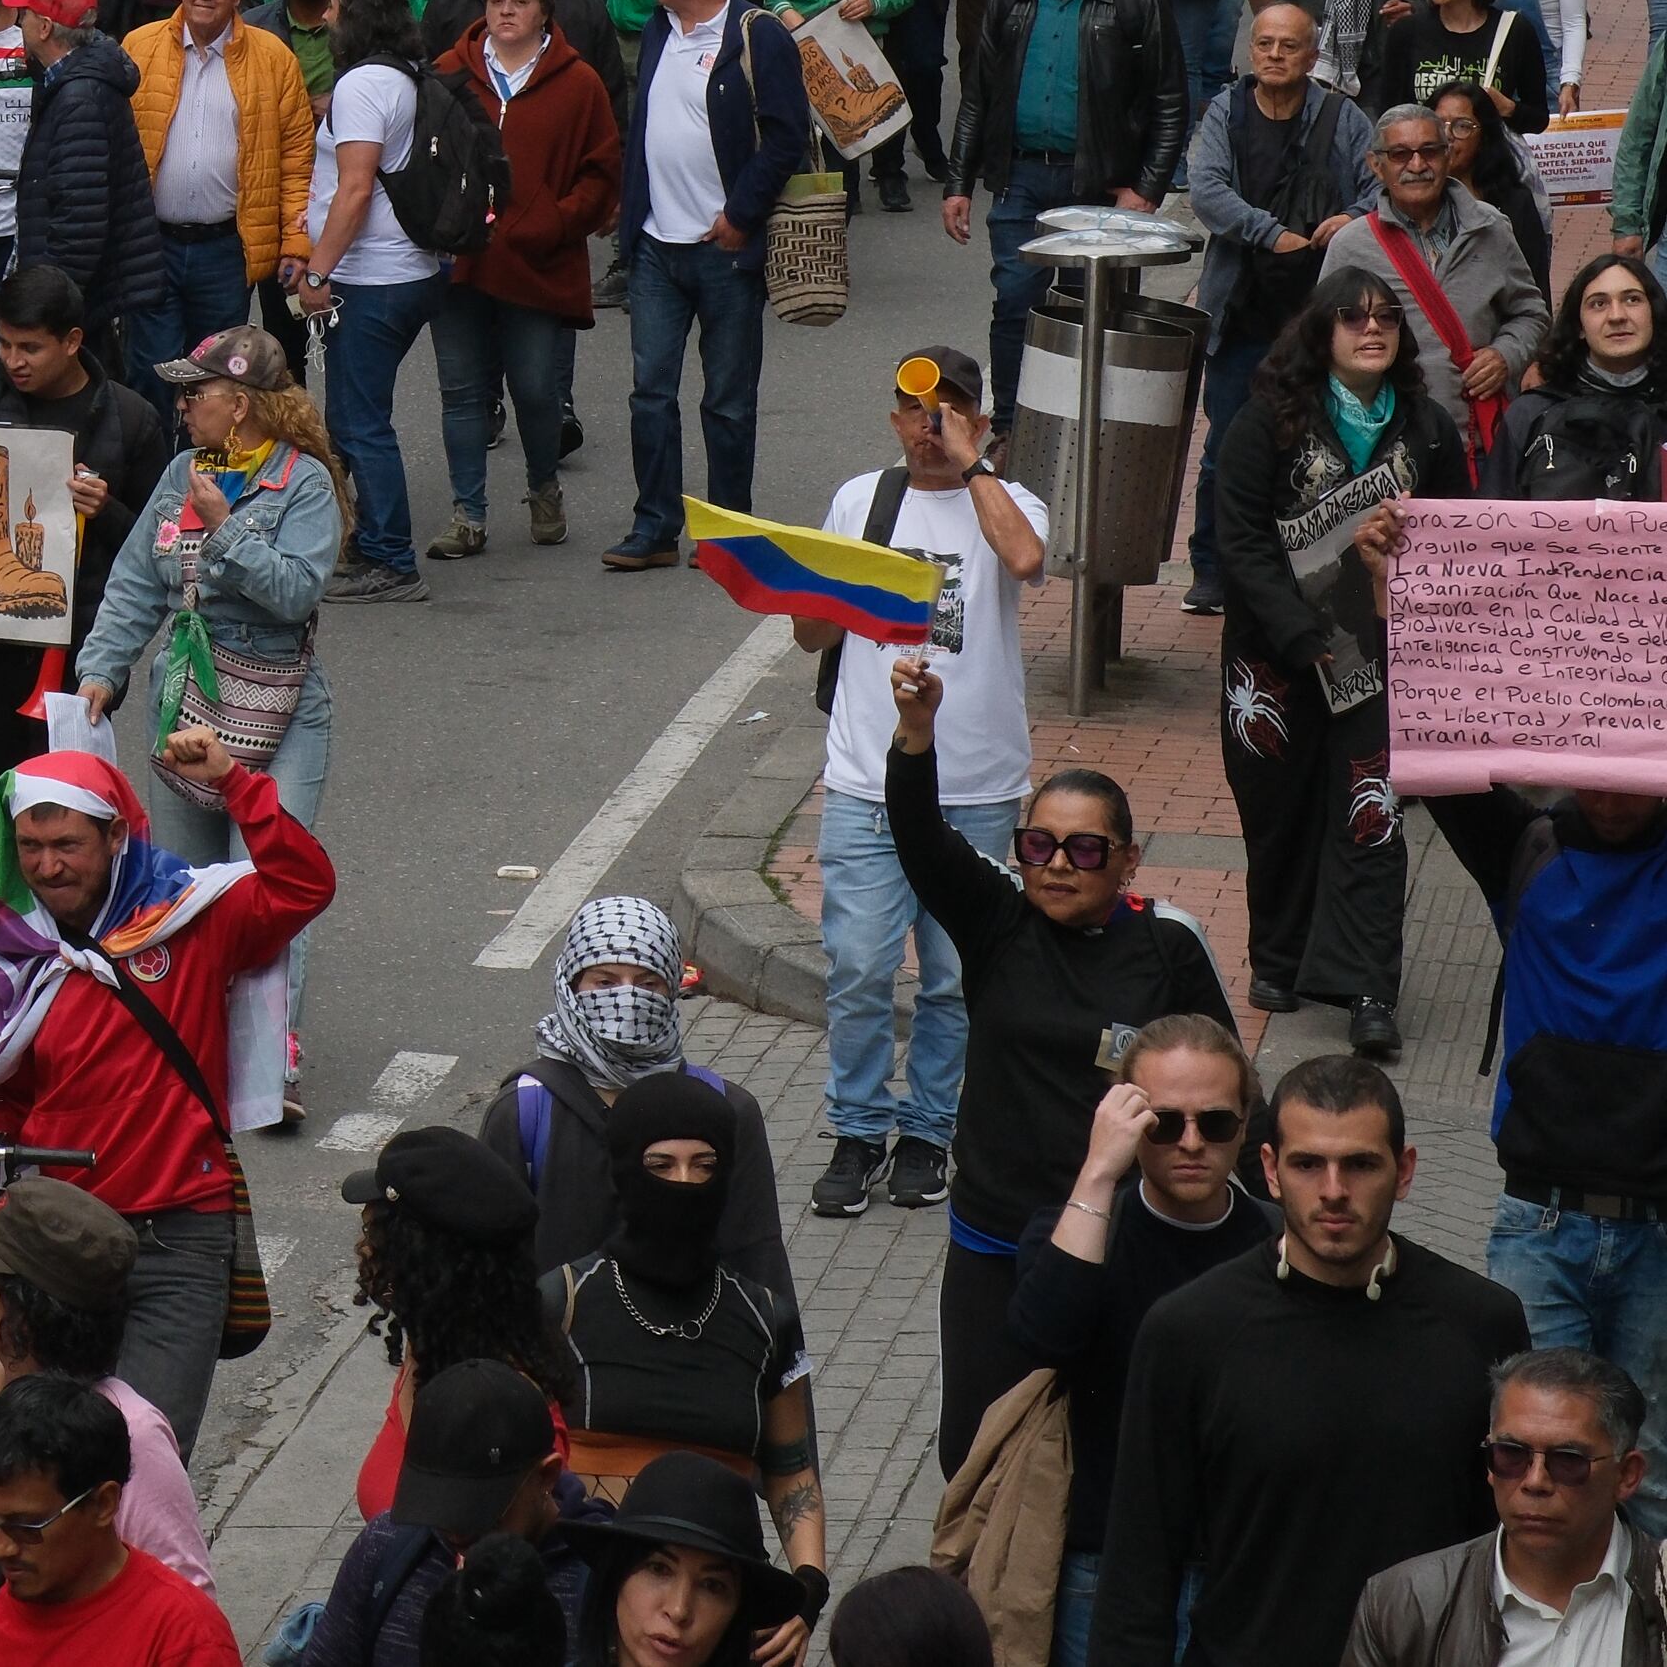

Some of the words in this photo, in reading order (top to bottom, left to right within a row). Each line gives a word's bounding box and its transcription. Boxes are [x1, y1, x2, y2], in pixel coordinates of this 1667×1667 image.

[816, 69, 837, 89] NOS
[1533, 151, 1576, 159] ALTRATA
[1585, 148, 1604, 157] SUS
[1543, 142, 1586, 152] ESCUELA
[1587, 140, 1607, 149] QUE
[1540, 166, 1592, 176] NJUSTICIA.
[1570, 157, 1612, 167] SIEMBRA
[1441, 560, 1506, 579] Nueva
[1388, 576, 1538, 602] Organización
[1594, 587, 1639, 606] Nace
[1550, 604, 1619, 627] Calidad
[1390, 612, 1534, 639] Biodiversidad
[1599, 631, 1630, 646] es
[1390, 651, 1504, 677] Amabilidad
[1392, 679, 1463, 705] Porque
[1506, 685, 1572, 708] Pueblo
